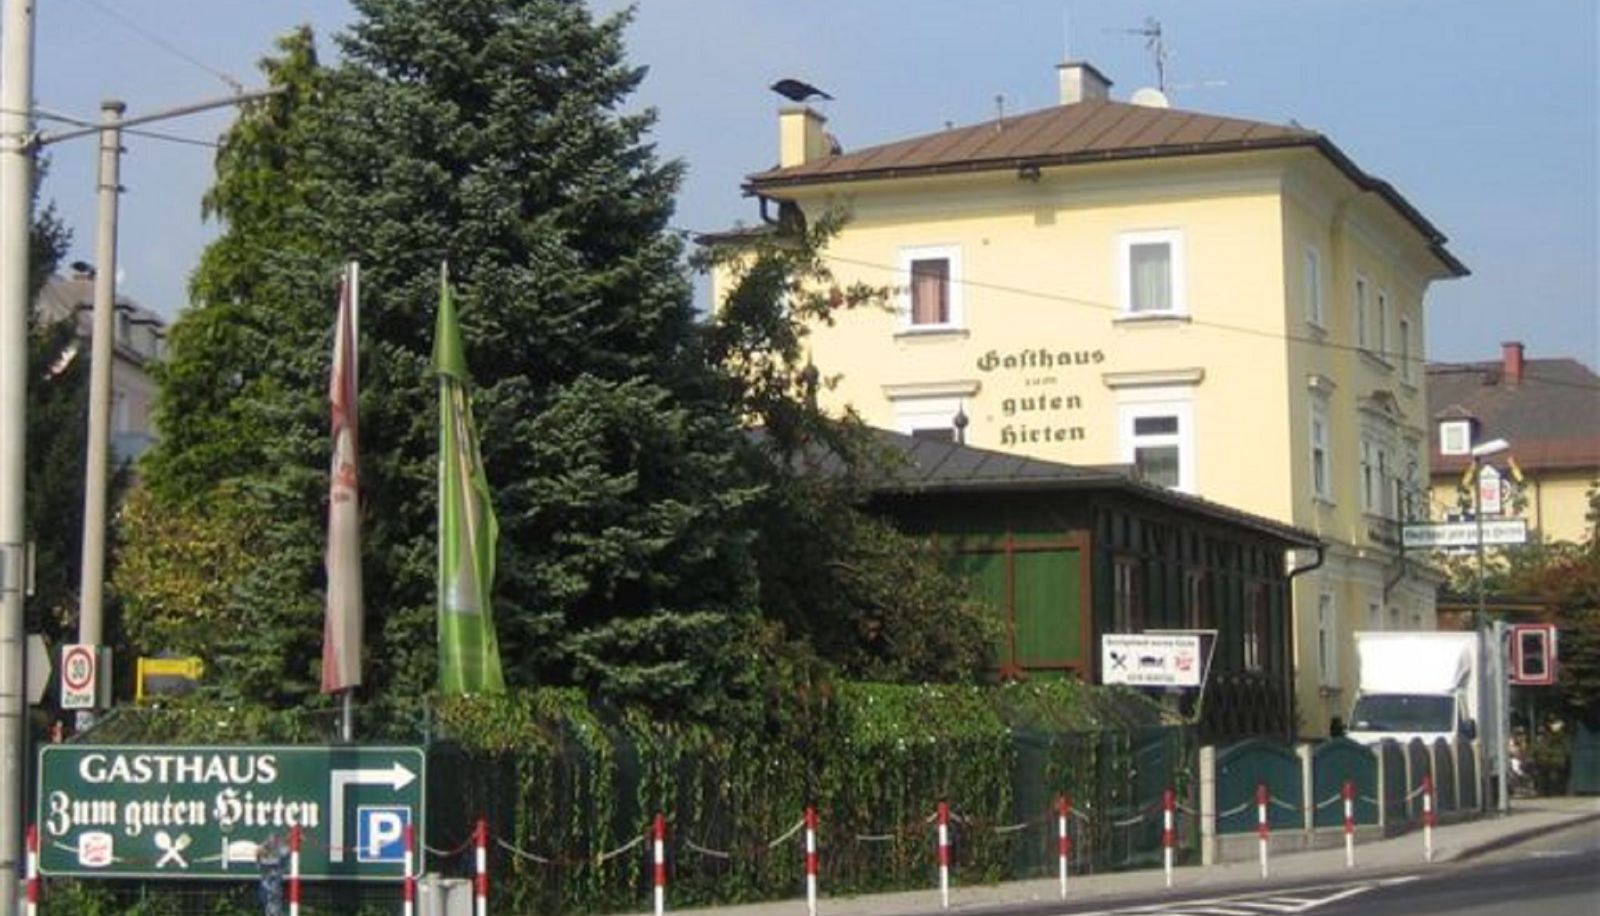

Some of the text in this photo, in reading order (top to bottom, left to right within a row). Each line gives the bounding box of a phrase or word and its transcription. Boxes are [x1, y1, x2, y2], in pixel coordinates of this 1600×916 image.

[1002, 394, 1082, 416] guten
[1001, 424, 1085, 446] Hirten
[72, 659, 85, 679] 30
[79, 754, 278, 784] GASTHAUS
[47, 787, 319, 837] Zum guten Hirten
[369, 812, 402, 857] P
